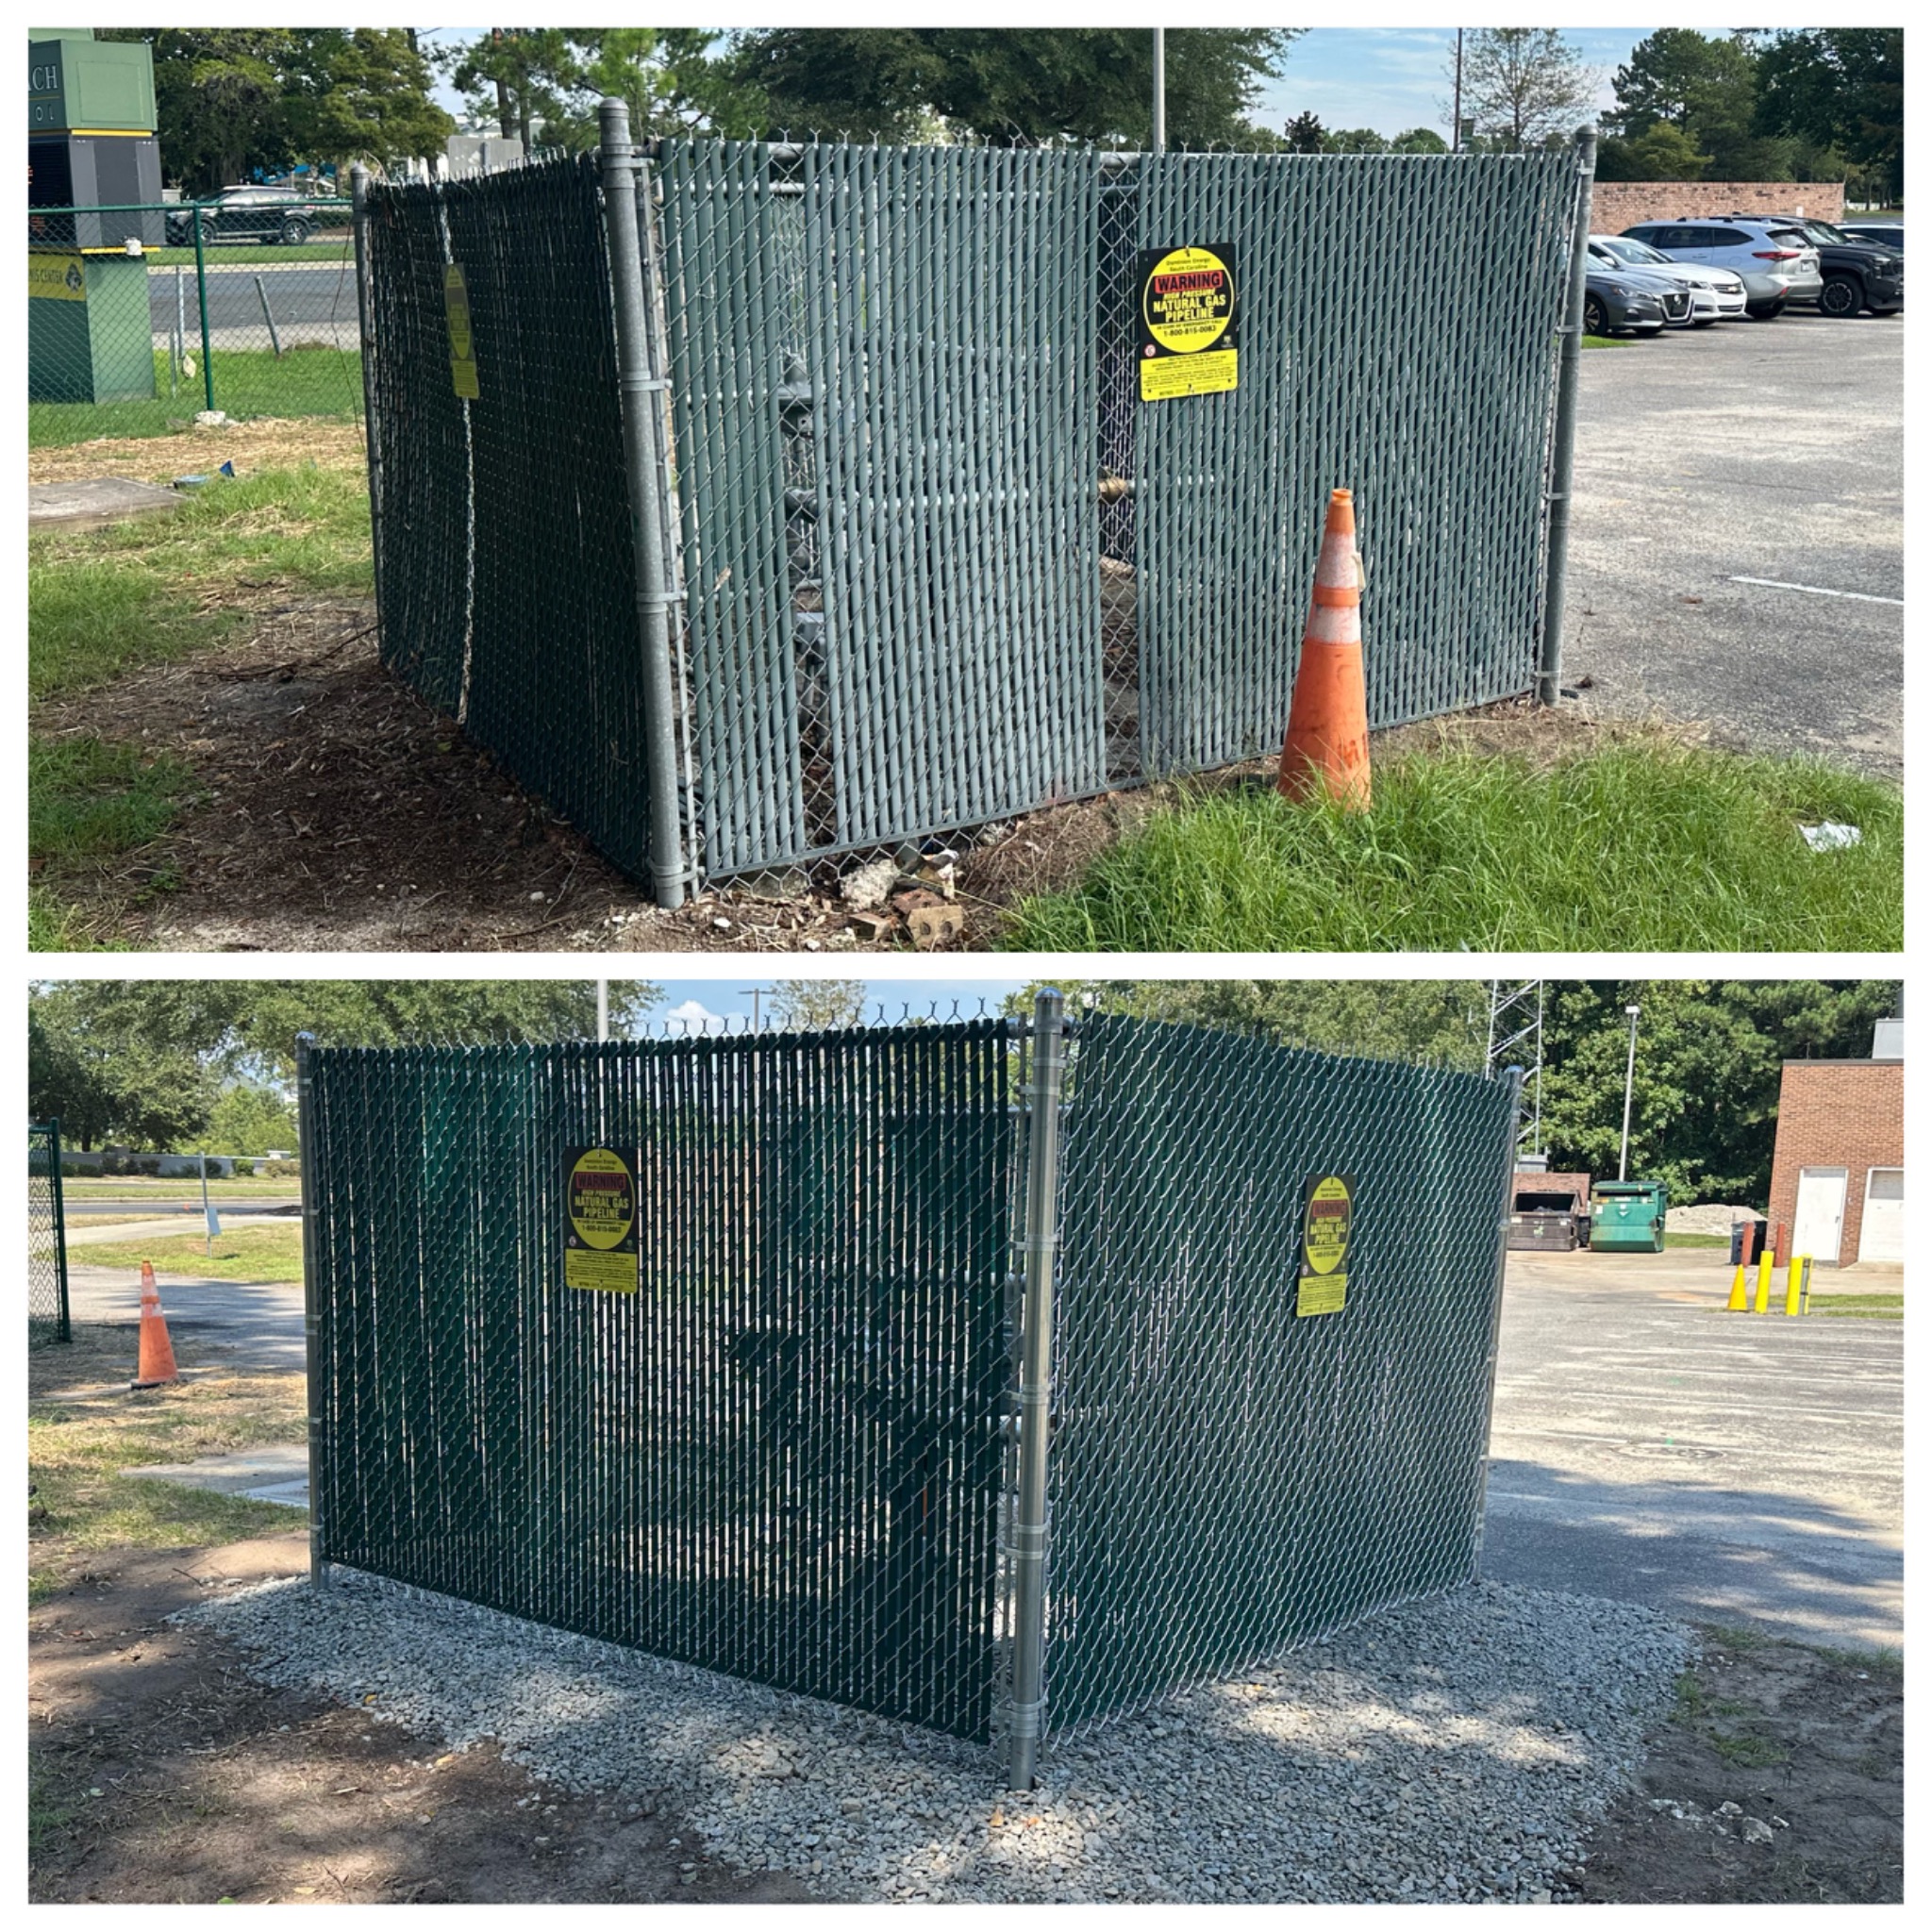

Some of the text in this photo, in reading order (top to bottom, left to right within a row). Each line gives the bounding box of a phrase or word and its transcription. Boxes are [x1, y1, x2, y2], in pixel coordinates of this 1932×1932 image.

[28, 65, 58, 92] CH
[1158, 272, 1221, 291] WARNING
[1153, 293, 1226, 313] NATURAL GAS
[1165, 307, 1214, 323] PIPELINE
[578, 1174, 624, 1189] WARNING
[575, 1195, 629, 1209] NATURAL GAS
[583, 1207, 620, 1219] PIPELINE
